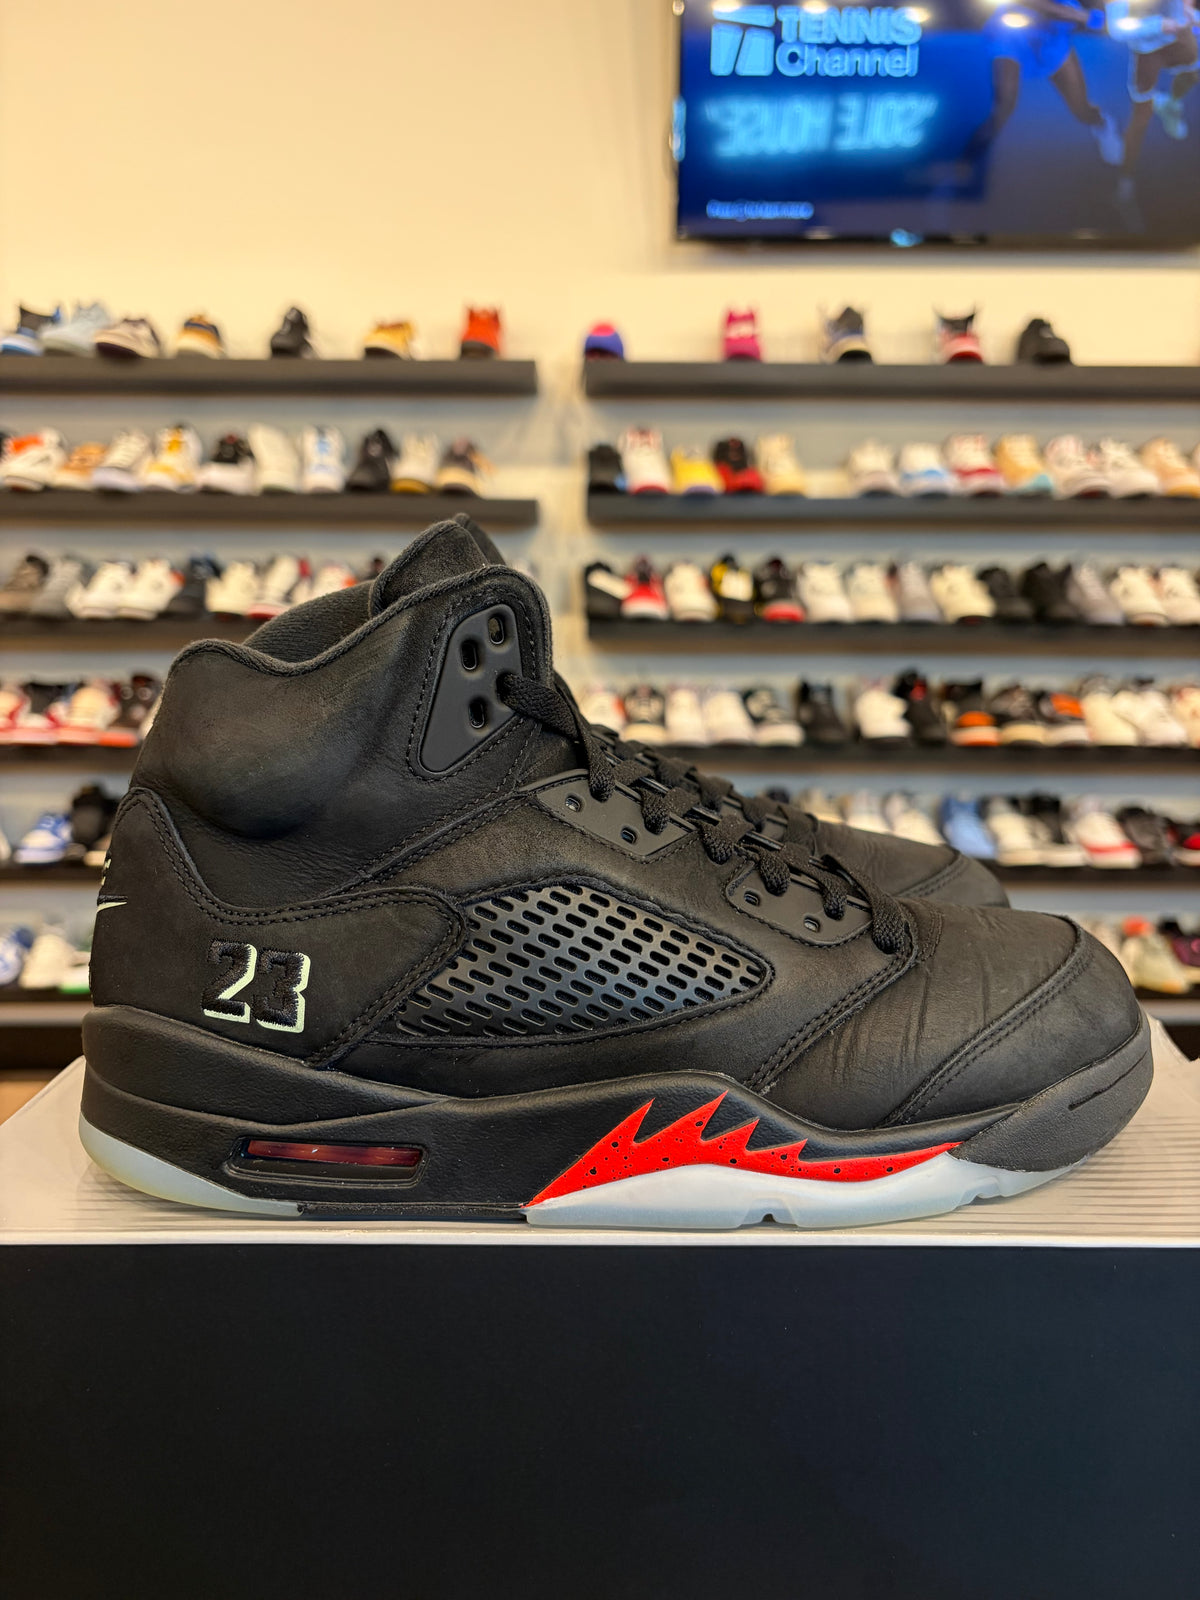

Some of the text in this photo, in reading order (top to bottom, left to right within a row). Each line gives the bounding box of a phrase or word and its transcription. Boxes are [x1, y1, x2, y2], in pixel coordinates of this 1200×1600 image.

[777, 5, 922, 45] TENNIS
[776, 42, 920, 77] Channel
[201, 939, 311, 1033] 23
